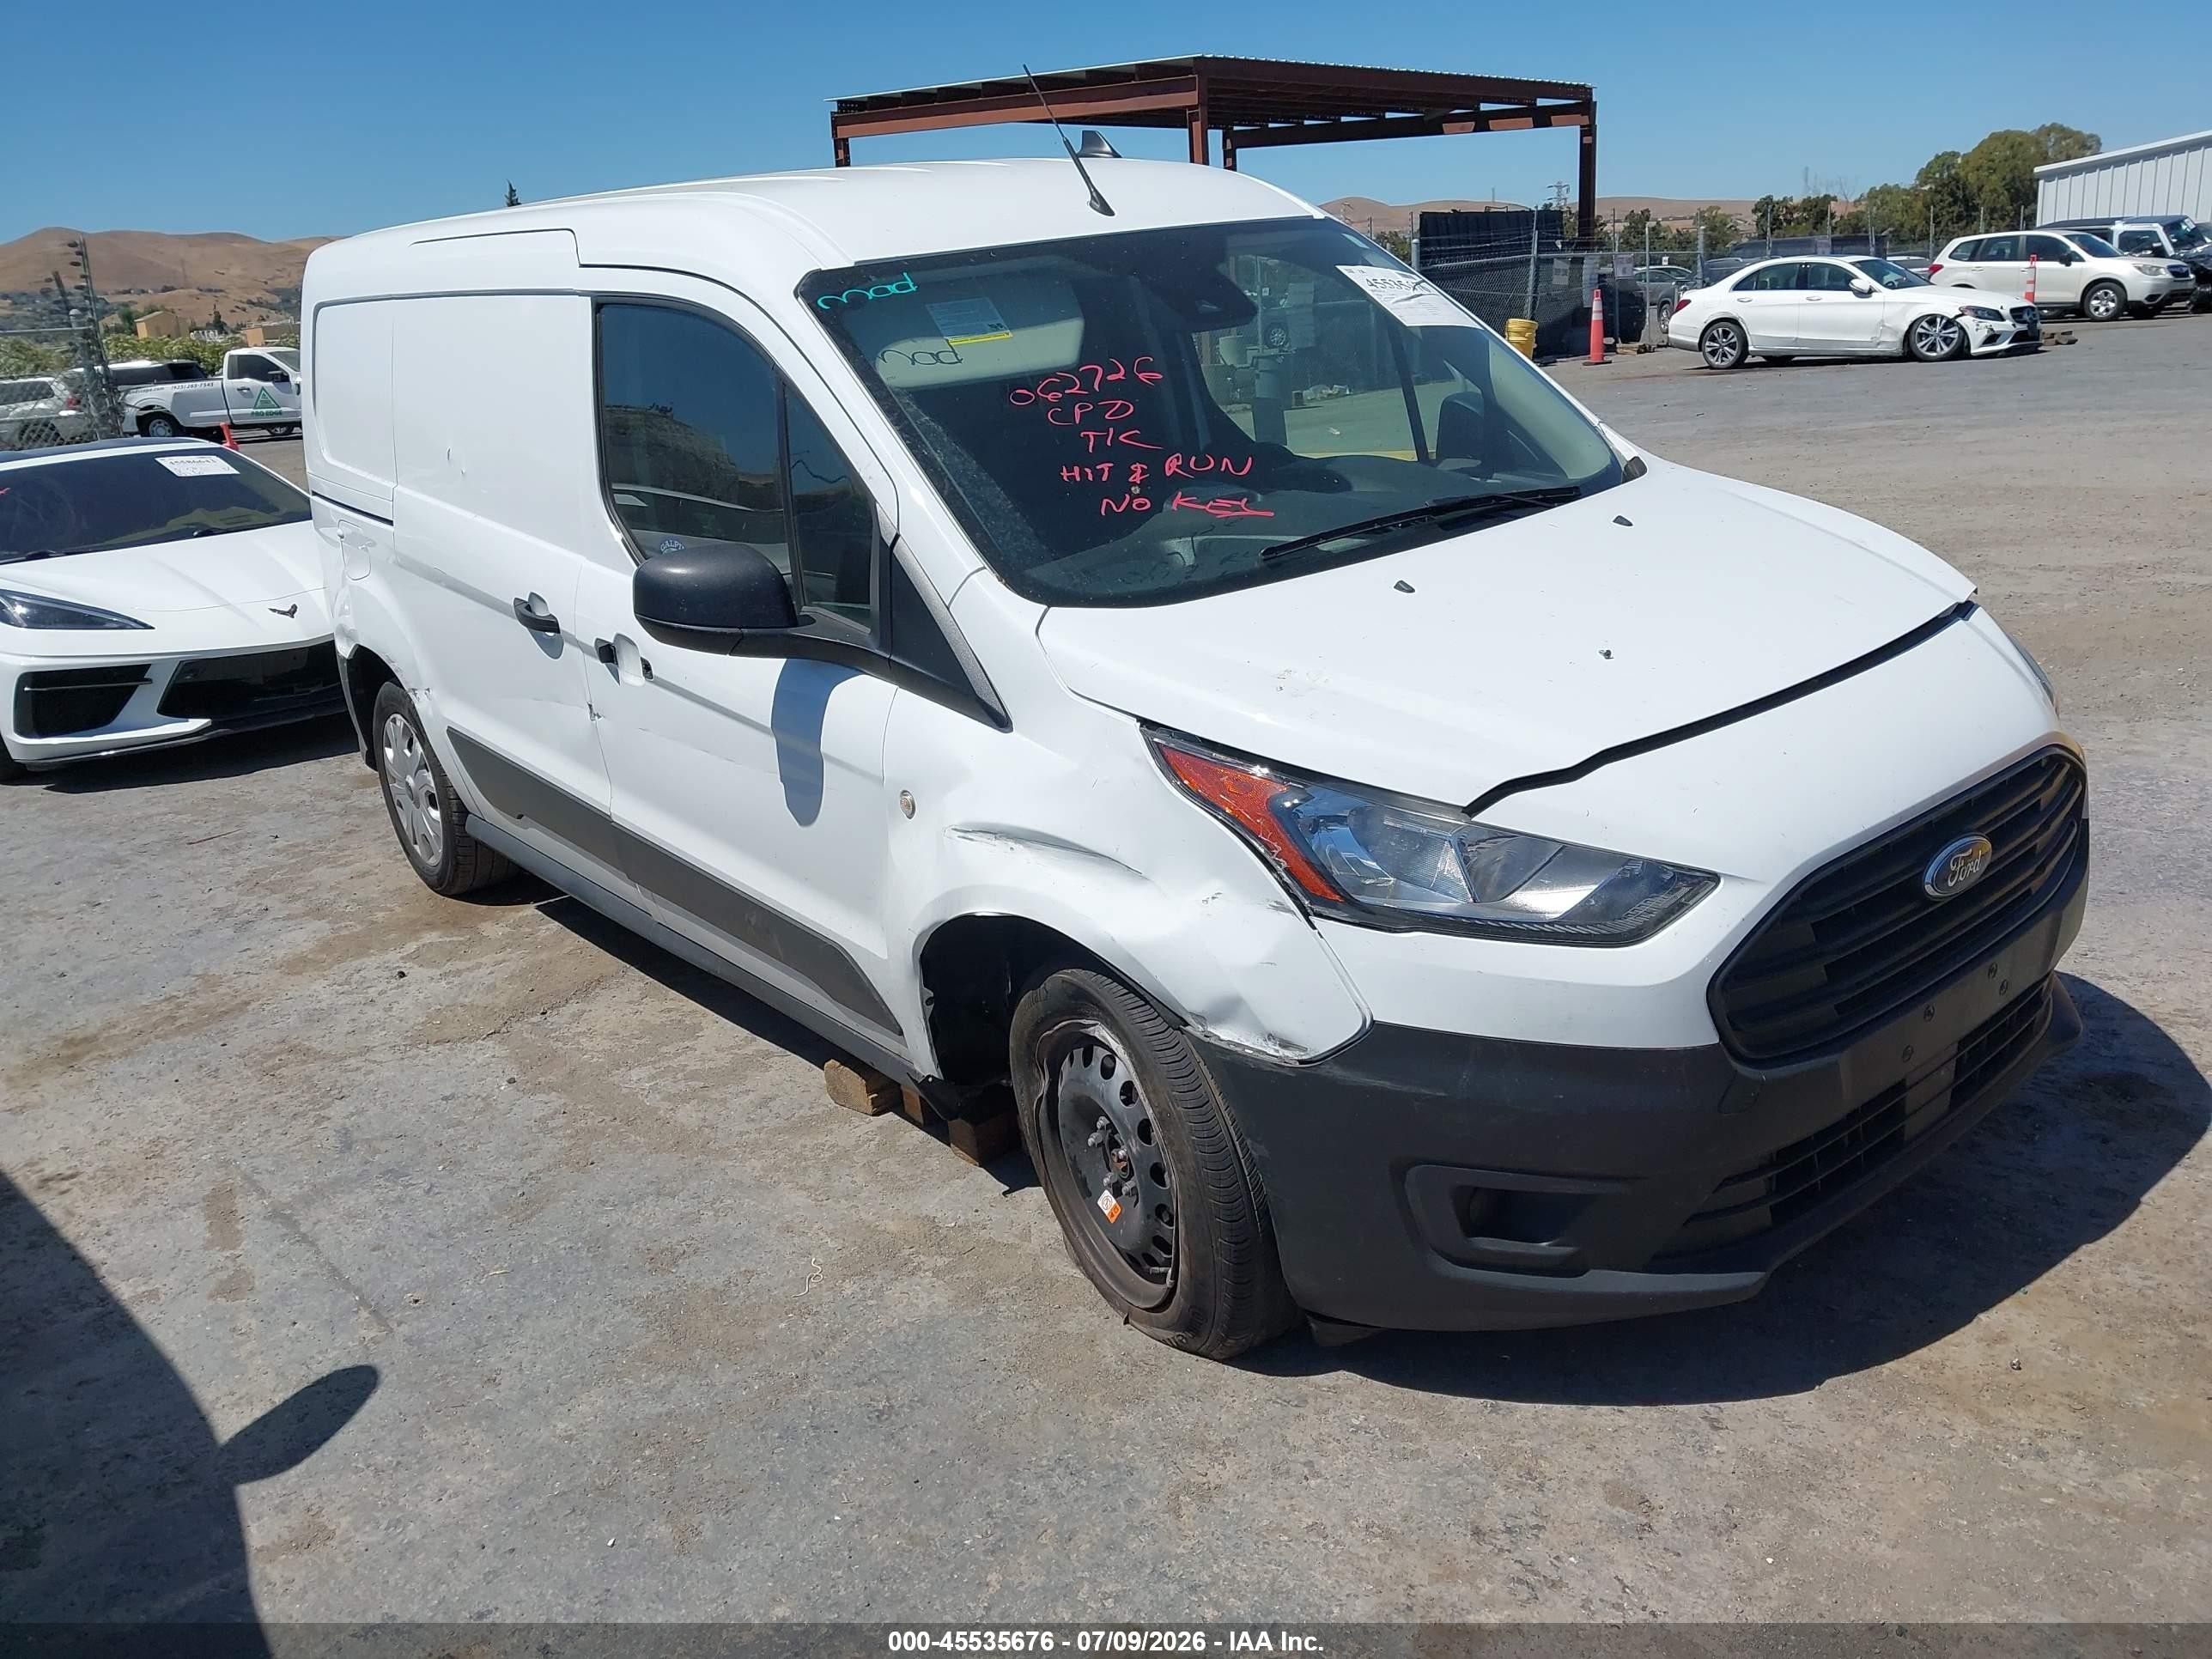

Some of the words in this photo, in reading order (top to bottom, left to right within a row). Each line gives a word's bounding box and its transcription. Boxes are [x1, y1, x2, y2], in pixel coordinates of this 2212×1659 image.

[1009, 356, 1163, 405] 062726
[1048, 400, 1134, 425] CPD
[1060, 463, 1114, 482] HIT
[1164, 453, 1254, 479] RUN
[1100, 493, 1152, 516] NO
[1948, 848, 1982, 887] Ford
